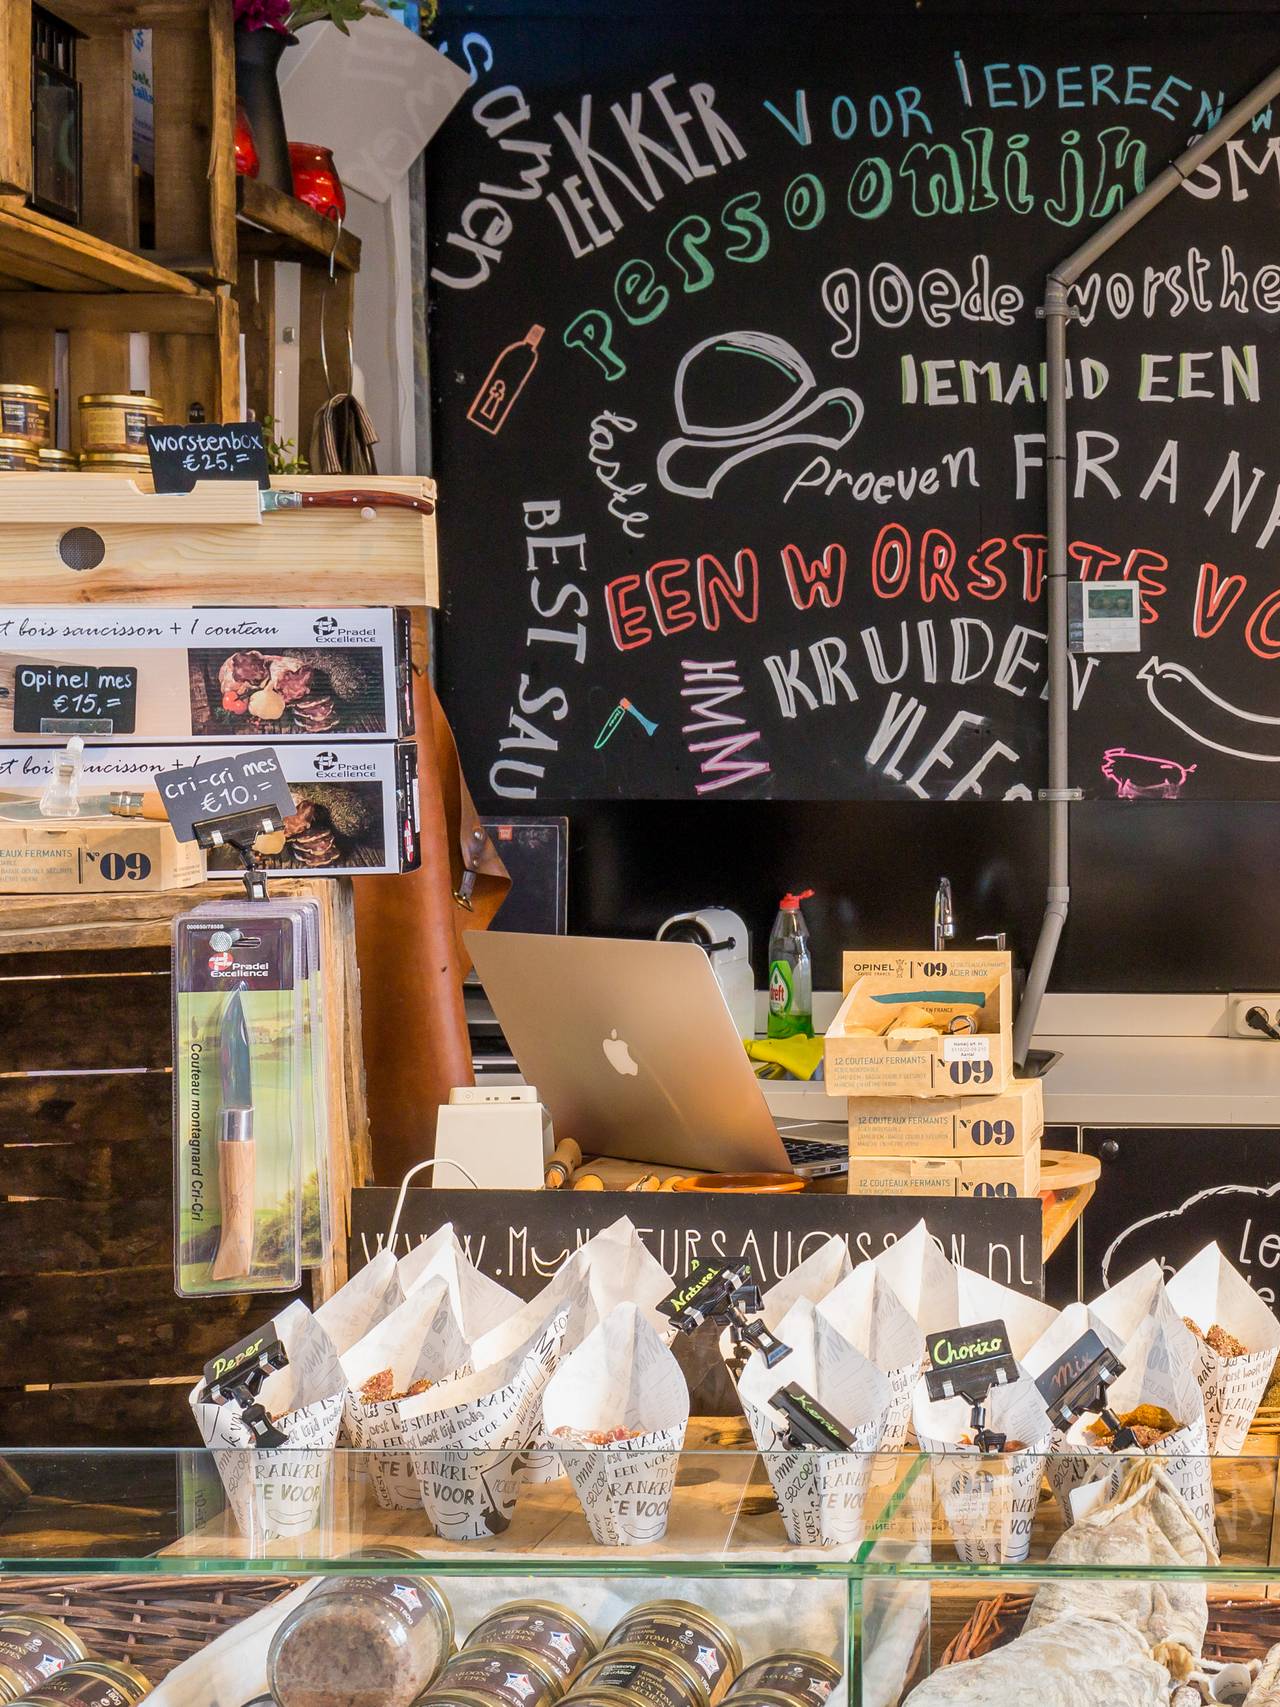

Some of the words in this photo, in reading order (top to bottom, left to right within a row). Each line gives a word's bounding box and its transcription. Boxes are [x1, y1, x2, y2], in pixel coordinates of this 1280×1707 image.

[763, 86, 934, 146] VOOR
[546, 73, 748, 259] LEKKER
[821, 254, 1026, 359] goede
[1138, 345, 1261, 405] EEN
[149, 431, 263, 453] worstenbox
[523, 499, 589, 664] BEST
[604, 546, 761, 652] EEN
[18, 617, 58, 638] bois
[62, 619, 163, 638] saucisson
[205, 620, 280, 637] couteau
[337, 626, 376, 636] Pradel
[315, 635, 377, 644] Excellence
[20, 670, 89, 689] Opinel
[98, 673, 133, 689] mes
[681, 658, 771, 795] HMM
[865, 690, 1034, 800] VLEE
[21, 755, 53, 774] boi
[242, 756, 278, 776] mes
[315, 770, 377, 779] Excellence
[337, 762, 376, 772] Pradel
[25, 848, 73, 858] FERMANTS
[210, 970, 269, 978] Excellence
[232, 962, 269, 970] Pradel
[853, 963, 895, 972] OPINEL
[949, 969, 970, 977] ACIER
[971, 969, 988, 977] INOX
[190, 1042, 203, 1097] Couteau
[833, 1057, 844, 1066] 12
[844, 1056, 883, 1065] COUTEAUX
[884, 1055, 927, 1065] FERMANTS
[858, 1116, 868, 1125] 12
[868, 1116, 906, 1125] COUTEAUX
[907, 1116, 949, 1125] FERMANTS
[190, 1099, 203, 1177] montagnard
[971, 1119, 1015, 1146] 09
[859, 1178, 868, 1187] 12
[869, 1178, 909, 1187] COUTEAUX
[910, 1178, 951, 1187] FERMANTS
[191, 1178, 204, 1222] Cri-Cri
[670, 1267, 721, 1313] Naturel
[212, 1338, 265, 1381] Peper
[933, 1336, 1003, 1365] Chorizo
[432, 1481, 475, 1506] VOOR
